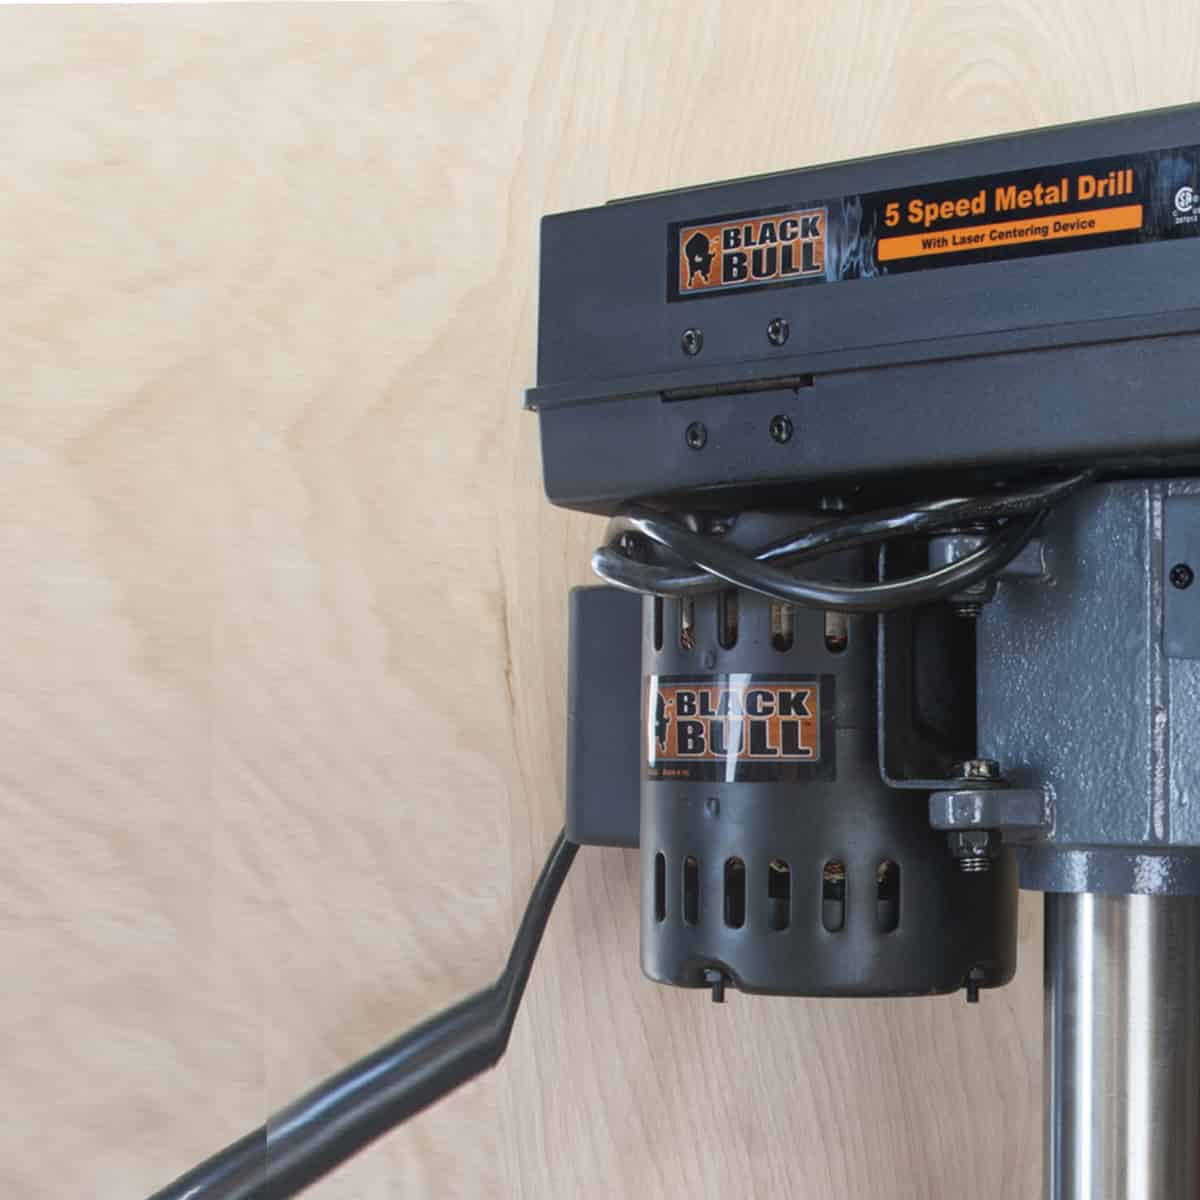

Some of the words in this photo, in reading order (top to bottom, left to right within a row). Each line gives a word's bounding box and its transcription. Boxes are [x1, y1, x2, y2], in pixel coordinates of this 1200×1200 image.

[884, 203, 900, 227] 5
[907, 190, 986, 228] Speed
[995, 178, 1069, 212] Metal
[1077, 168, 1134, 201] Drill
[722, 215, 821, 251] BLACK
[921, 236, 949, 250] With
[952, 232, 985, 246] Laser
[988, 223, 1049, 241] Centering
[1053, 216, 1096, 233] Device
[722, 241, 821, 284] BULL
[676, 689, 812, 718] BLACK
[676, 719, 813, 757] BULL
